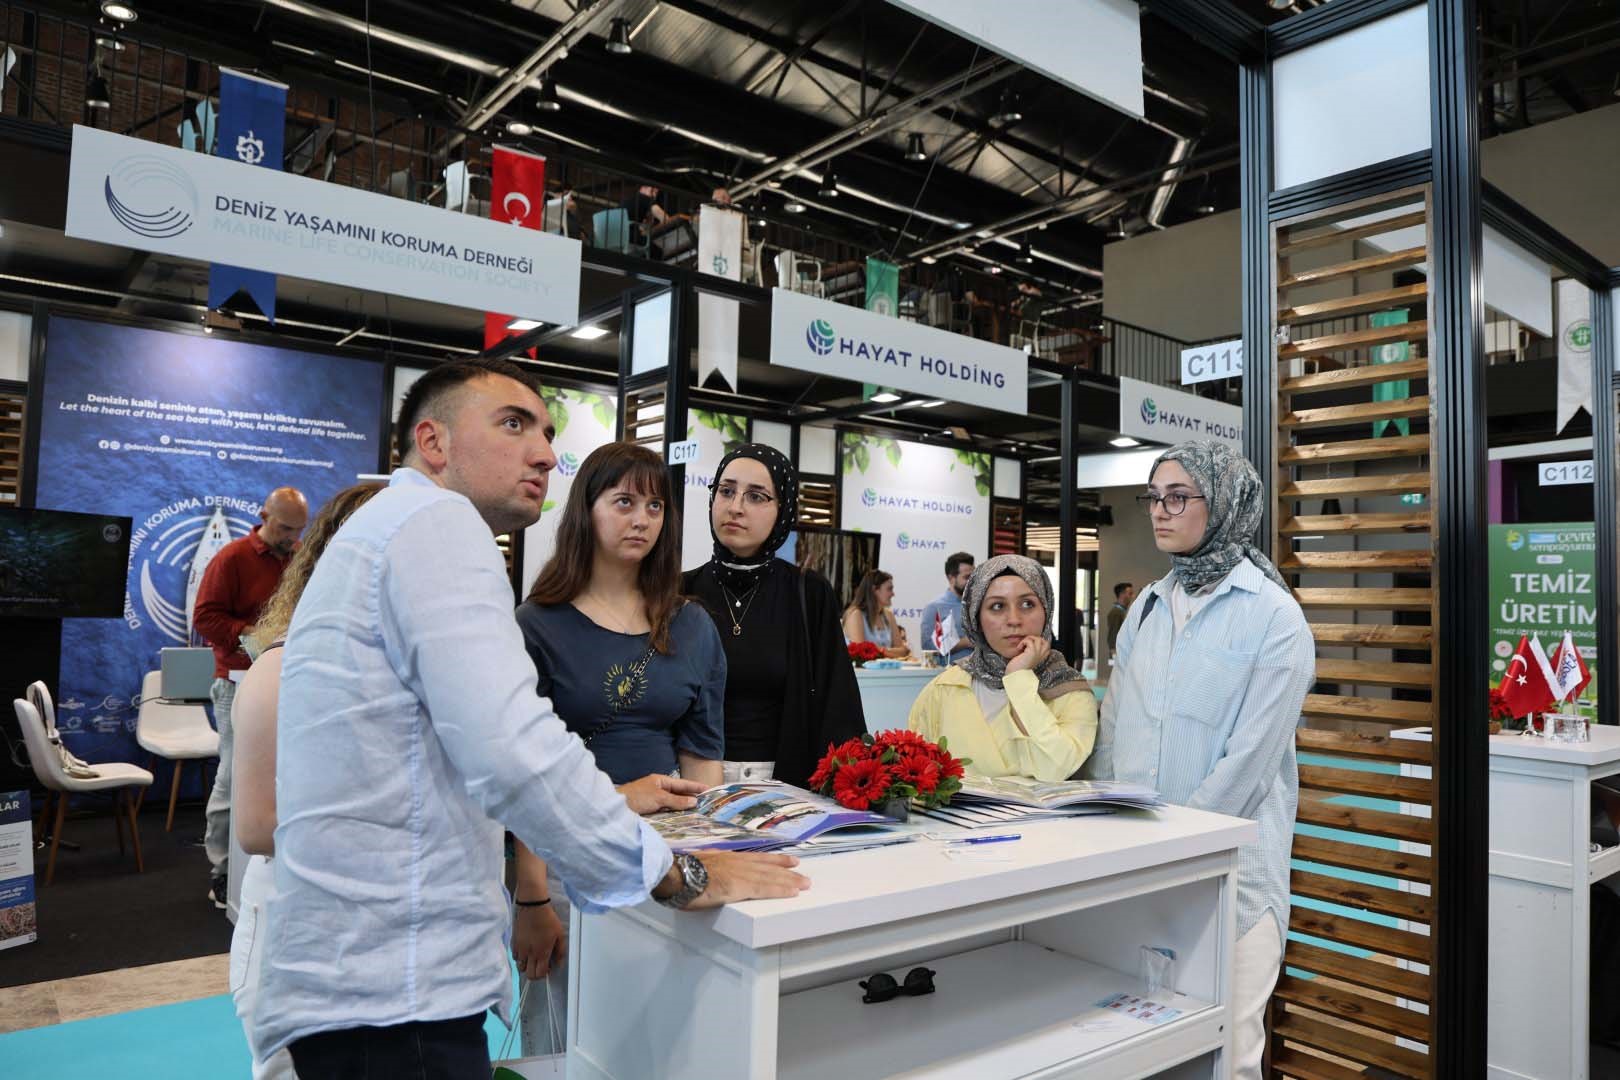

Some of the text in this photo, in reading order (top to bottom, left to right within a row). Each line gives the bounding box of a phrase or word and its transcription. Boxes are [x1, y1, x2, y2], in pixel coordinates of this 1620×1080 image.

[215, 195, 533, 275] DENİZ YAŞAMINI KORUMA DERNEĞİ
[839, 336, 1005, 389] HAYAT HOLDİNG
[59, 401, 78, 411] Let
[80, 403, 99, 413] the
[101, 405, 131, 417] heart
[132, 408, 145, 418] of
[146, 409, 164, 420] the
[165, 413, 185, 422] sea
[186, 414, 209, 425] beat
[211, 418, 234, 427] with
[277, 424, 310, 435] defend
[311, 427, 326, 436] life
[87, 393, 129, 406] Denizin
[131, 398, 157, 409] kalbi
[159, 401, 197, 413] seninle
[263, 412, 297, 424] birlikte
[1159, 409, 1242, 441] HAYAT HOLDİ
[674, 443, 698, 460] C117
[1544, 464, 1593, 482] C112
[144, 497, 202, 531] KORUMA
[879, 496, 973, 515] HAYAT HOLDİNG
[911, 538, 947, 550] HAYAT
[1510, 569, 1592, 594] TEMİZ
[893, 607, 923, 619] KAST
[1501, 598, 1597, 625] ÜRETİM
